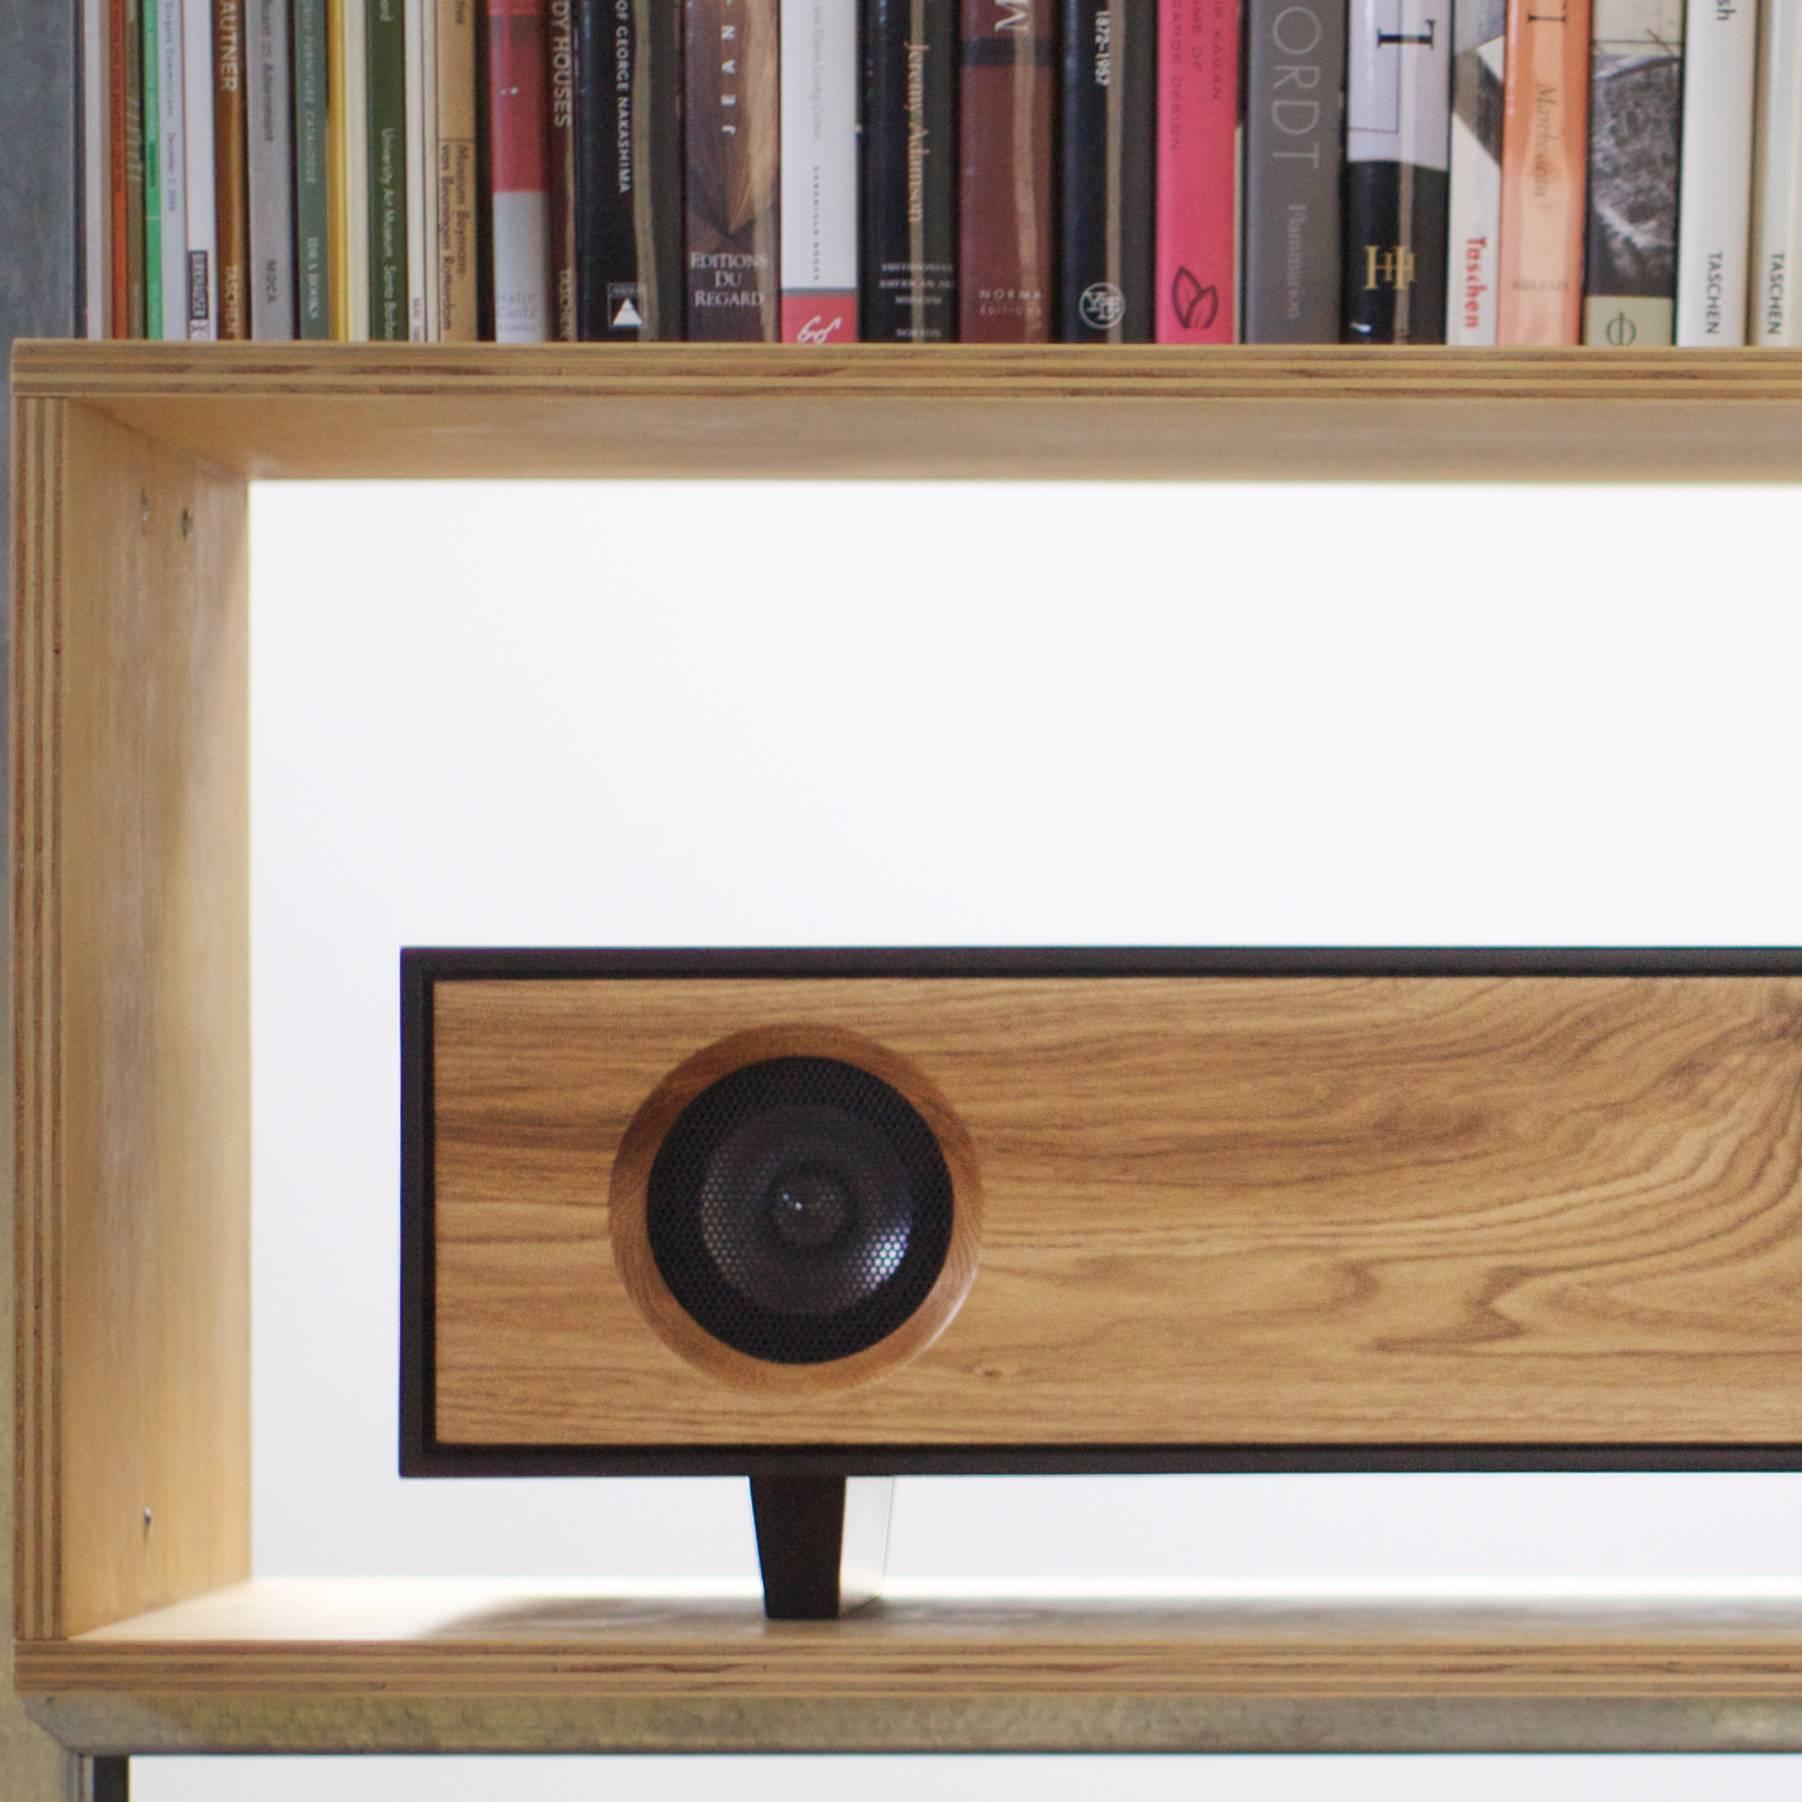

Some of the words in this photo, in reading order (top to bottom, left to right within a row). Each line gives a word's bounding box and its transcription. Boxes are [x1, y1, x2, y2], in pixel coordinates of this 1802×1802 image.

[554, 37, 569, 128] HOUSES
[615, 26, 628, 92] GEORGE
[904, 41, 928, 112] Jeremy
[617, 97, 630, 193] NAKASHIMA
[906, 122, 928, 223] Adamson
[225, 264, 239, 334] TASCHEN
[443, 256, 454, 330] Rotterdam
[693, 290, 766, 308] REGARD
[714, 270, 743, 287] DU
[1285, 204, 1306, 319] Flammarion
[1466, 237, 1487, 328] Taschen
[1706, 252, 1723, 334] TASCHEN
[1768, 252, 1785, 334] TASCHEN
[559, 270, 571, 338] TASCHEN
